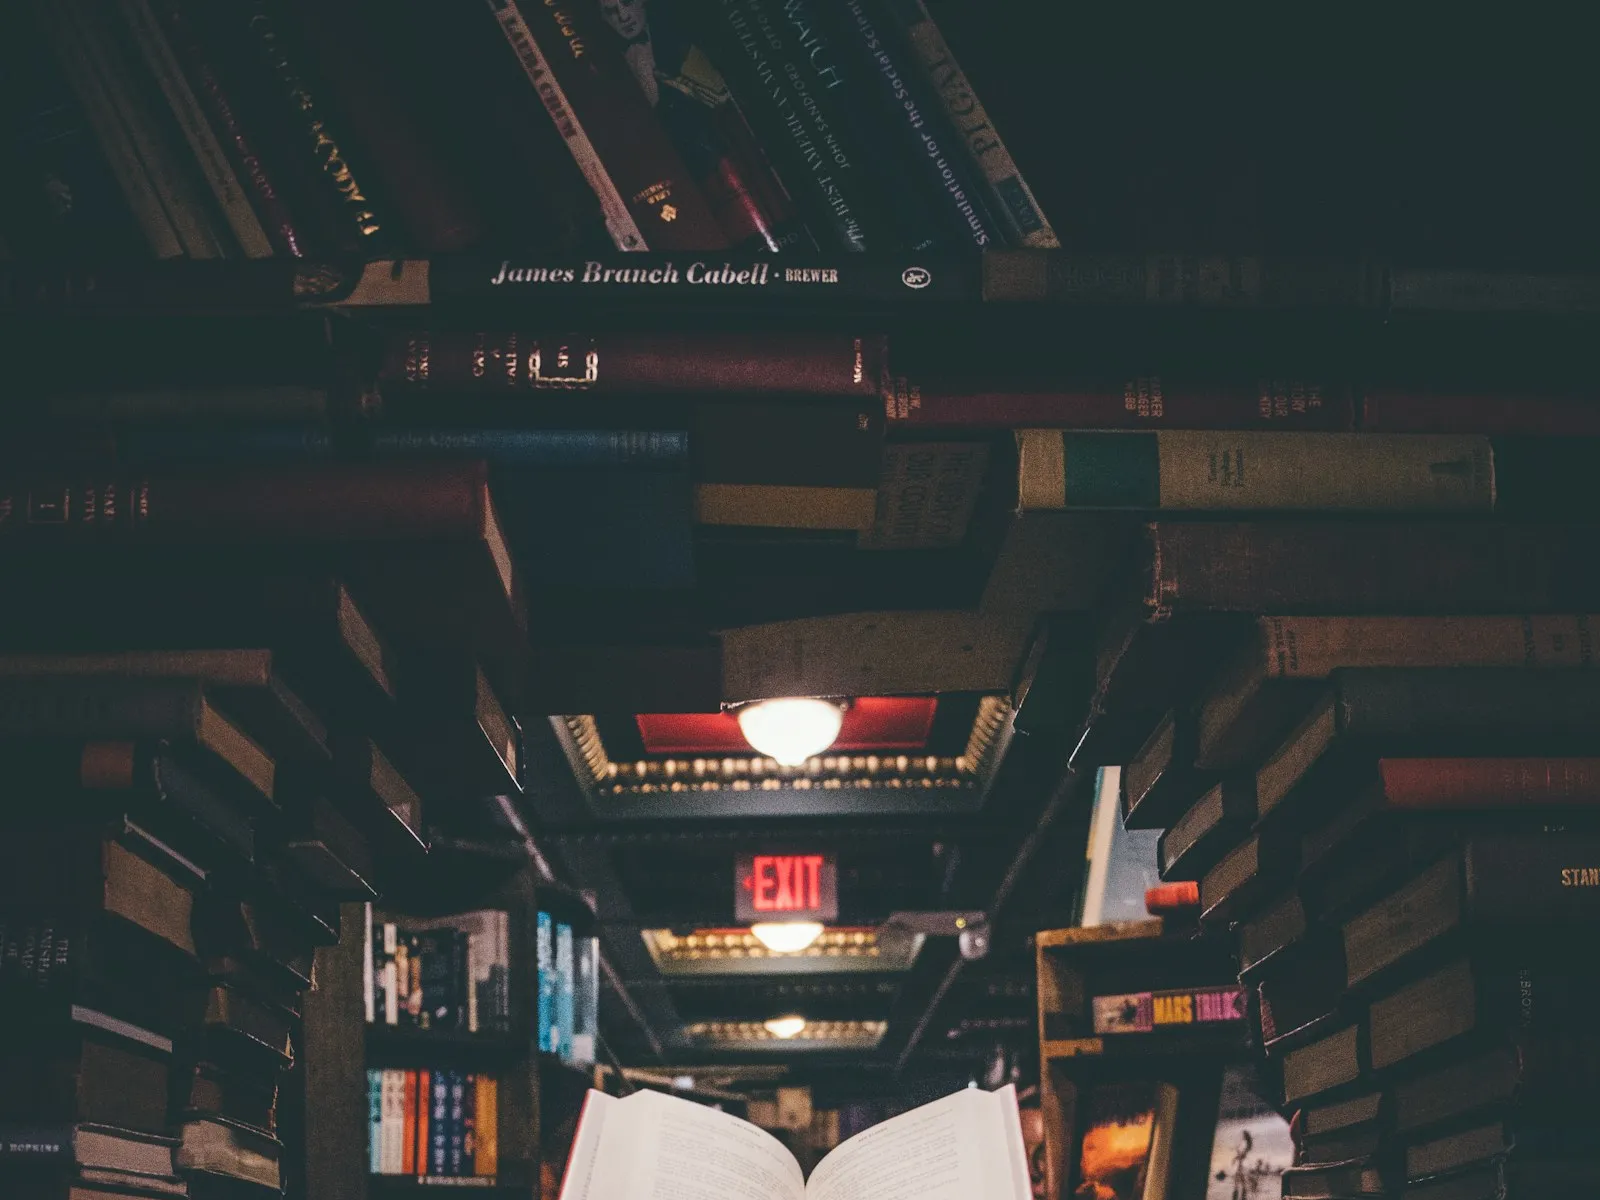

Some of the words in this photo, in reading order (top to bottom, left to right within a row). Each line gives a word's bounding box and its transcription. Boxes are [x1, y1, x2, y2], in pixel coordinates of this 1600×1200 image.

[870, 49, 911, 101] Social
[899, 98, 927, 129] the
[917, 129, 943, 158] for
[932, 154, 990, 248] Simulation
[491, 260, 574, 287] James
[580, 261, 679, 286] Branch
[686, 261, 769, 286] Cabell
[785, 267, 840, 284] BREWER
[753, 856, 823, 910] EXIT
[1153, 994, 1193, 1025] MARS
[9, 1142, 61, 1153] HOPKINS
